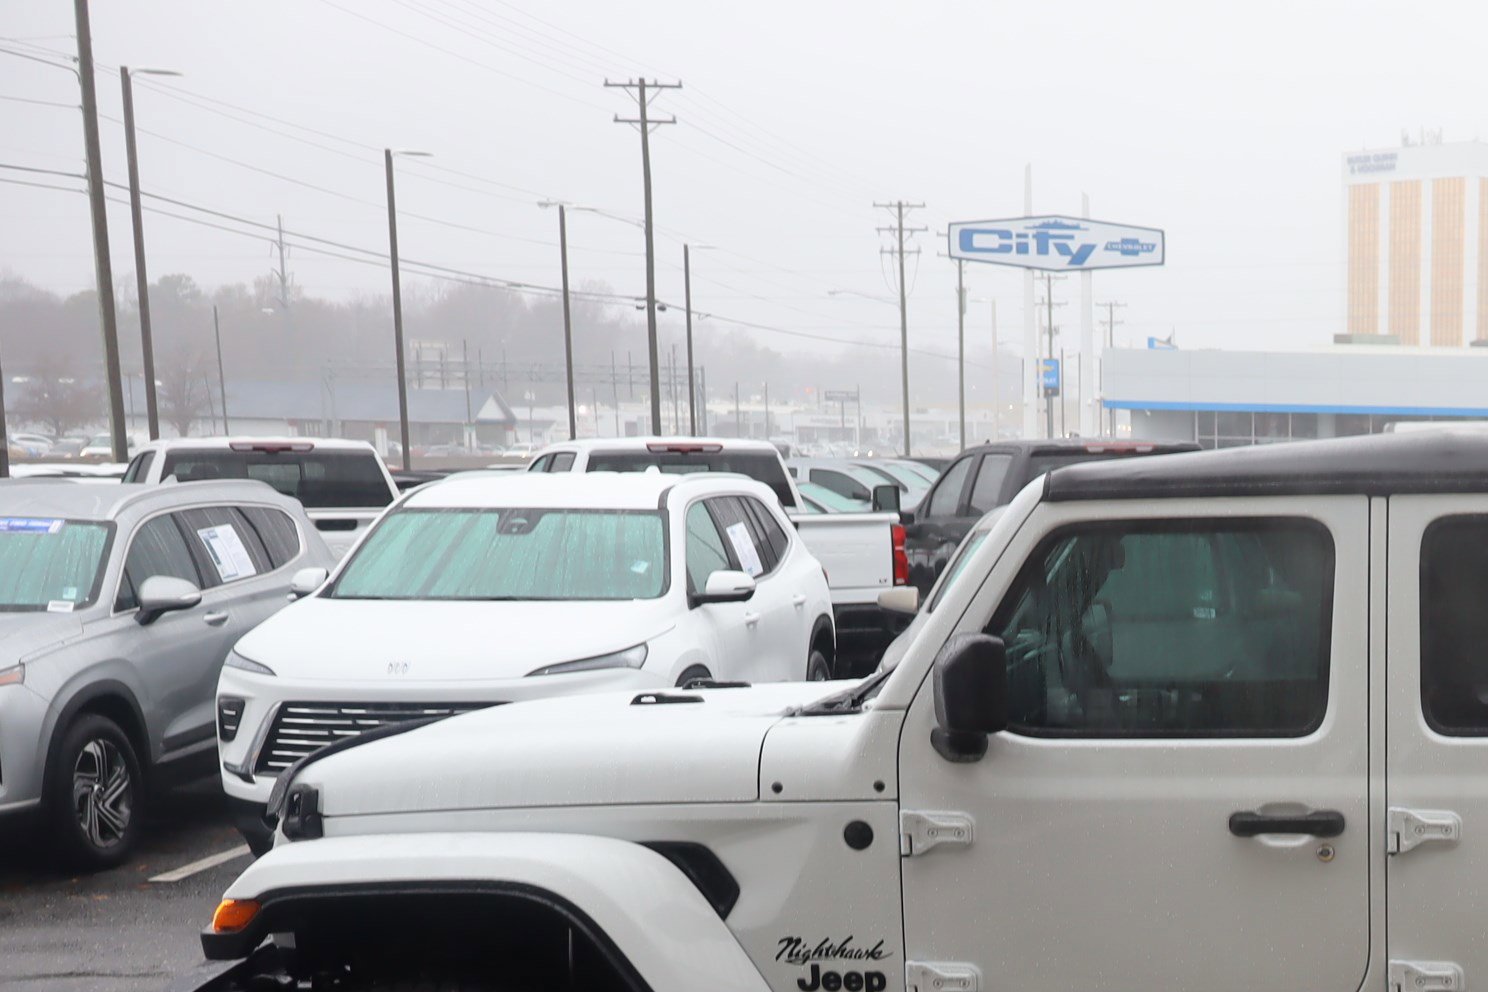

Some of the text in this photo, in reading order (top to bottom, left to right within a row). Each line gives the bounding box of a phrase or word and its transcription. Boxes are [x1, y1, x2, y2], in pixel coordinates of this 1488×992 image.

[959, 229, 1097, 266] City
[1107, 240, 1154, 251] CHEVROLET
[775, 935, 893, 965] Nighthawk
